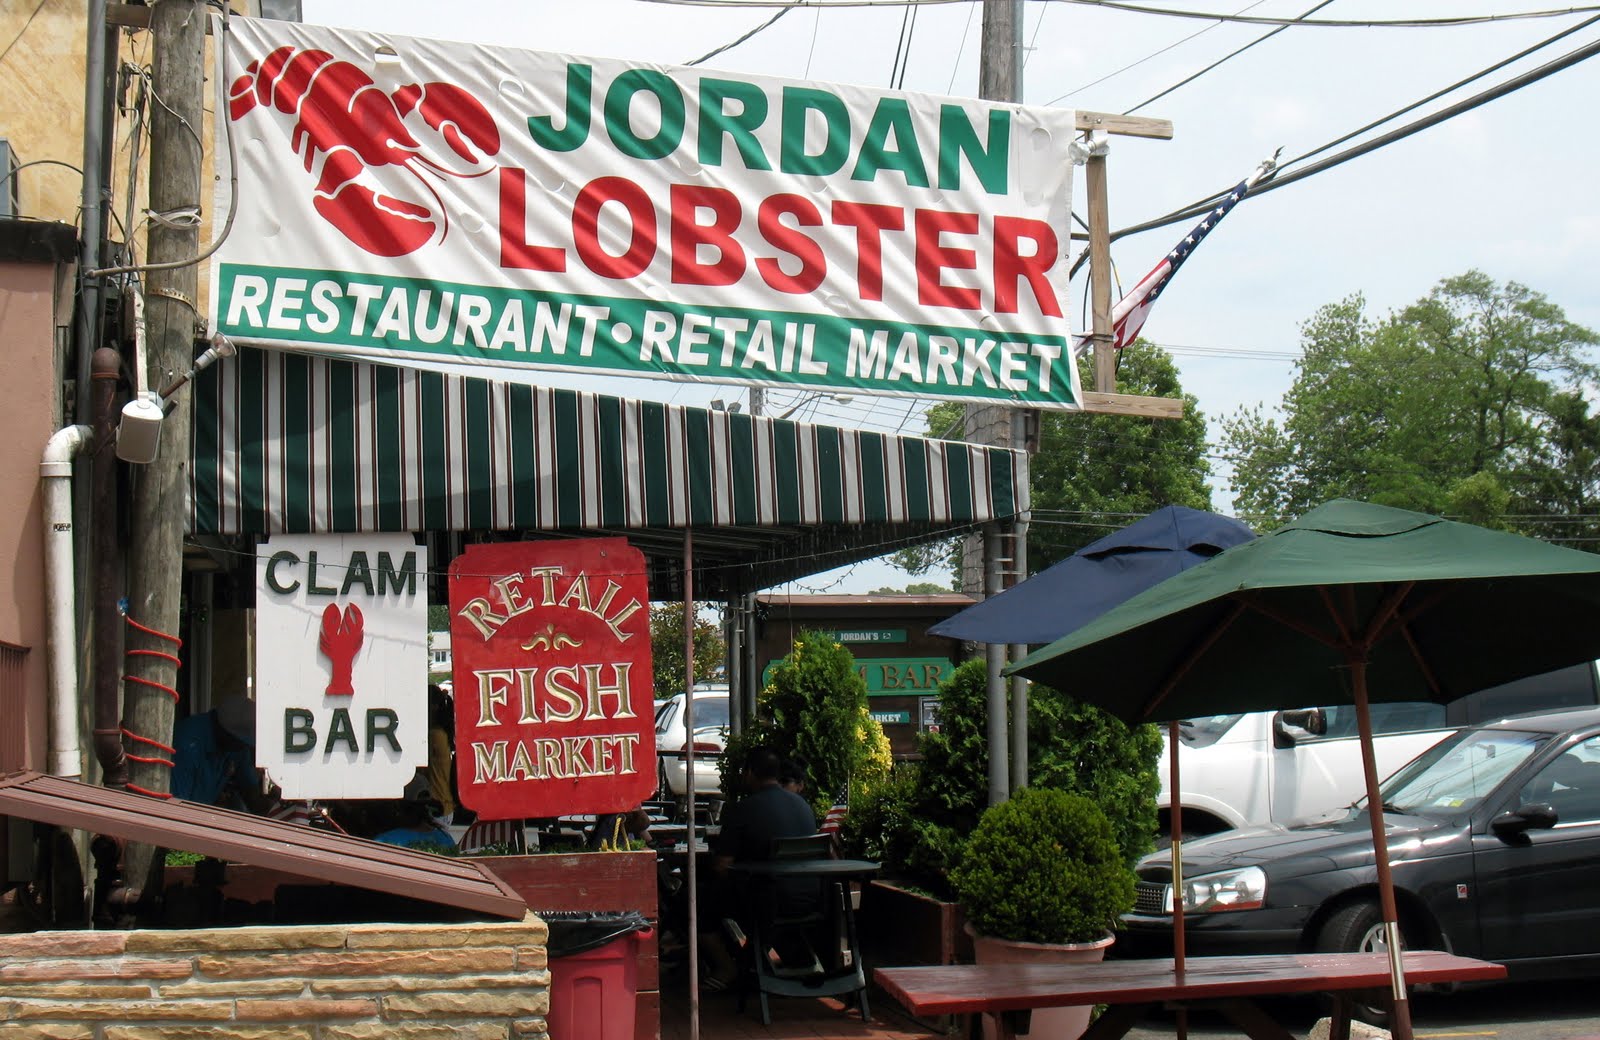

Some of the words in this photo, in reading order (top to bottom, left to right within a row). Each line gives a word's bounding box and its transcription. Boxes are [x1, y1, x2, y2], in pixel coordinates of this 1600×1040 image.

[527, 63, 1010, 195] JORDAN
[500, 167, 1063, 318] LOBSTER
[226, 274, 610, 356] RESTAURANT
[639, 310, 828, 375] RETAIL
[845, 328, 1062, 392] MARKET
[266, 550, 416, 596] CLAM
[457, 565, 642, 643] RETAIL
[840, 632, 879, 641] JORDAN'S
[472, 662, 638, 728] FISH
[881, 664, 943, 689] BAR
[285, 707, 402, 754] BAR
[868, 713, 901, 723] ARKET
[471, 733, 640, 784] MARKET
